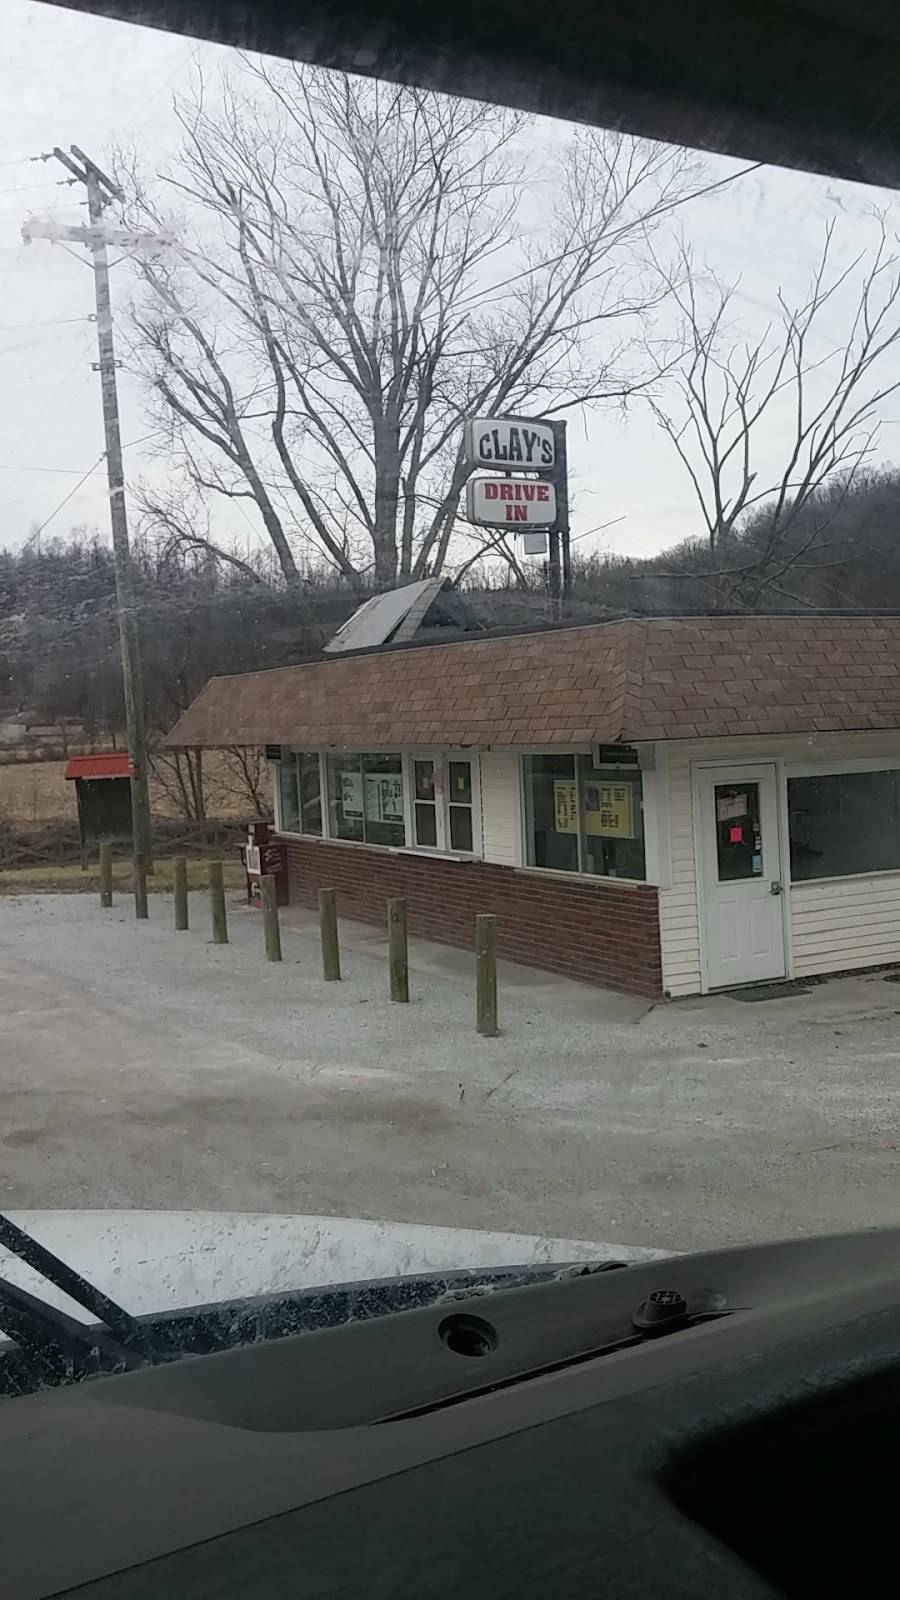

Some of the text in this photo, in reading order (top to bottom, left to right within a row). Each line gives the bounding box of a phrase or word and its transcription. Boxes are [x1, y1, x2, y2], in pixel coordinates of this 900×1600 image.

[479, 427, 553, 464] CLAY'S
[484, 482, 549, 501] DRIVE
[505, 504, 528, 521] IN
